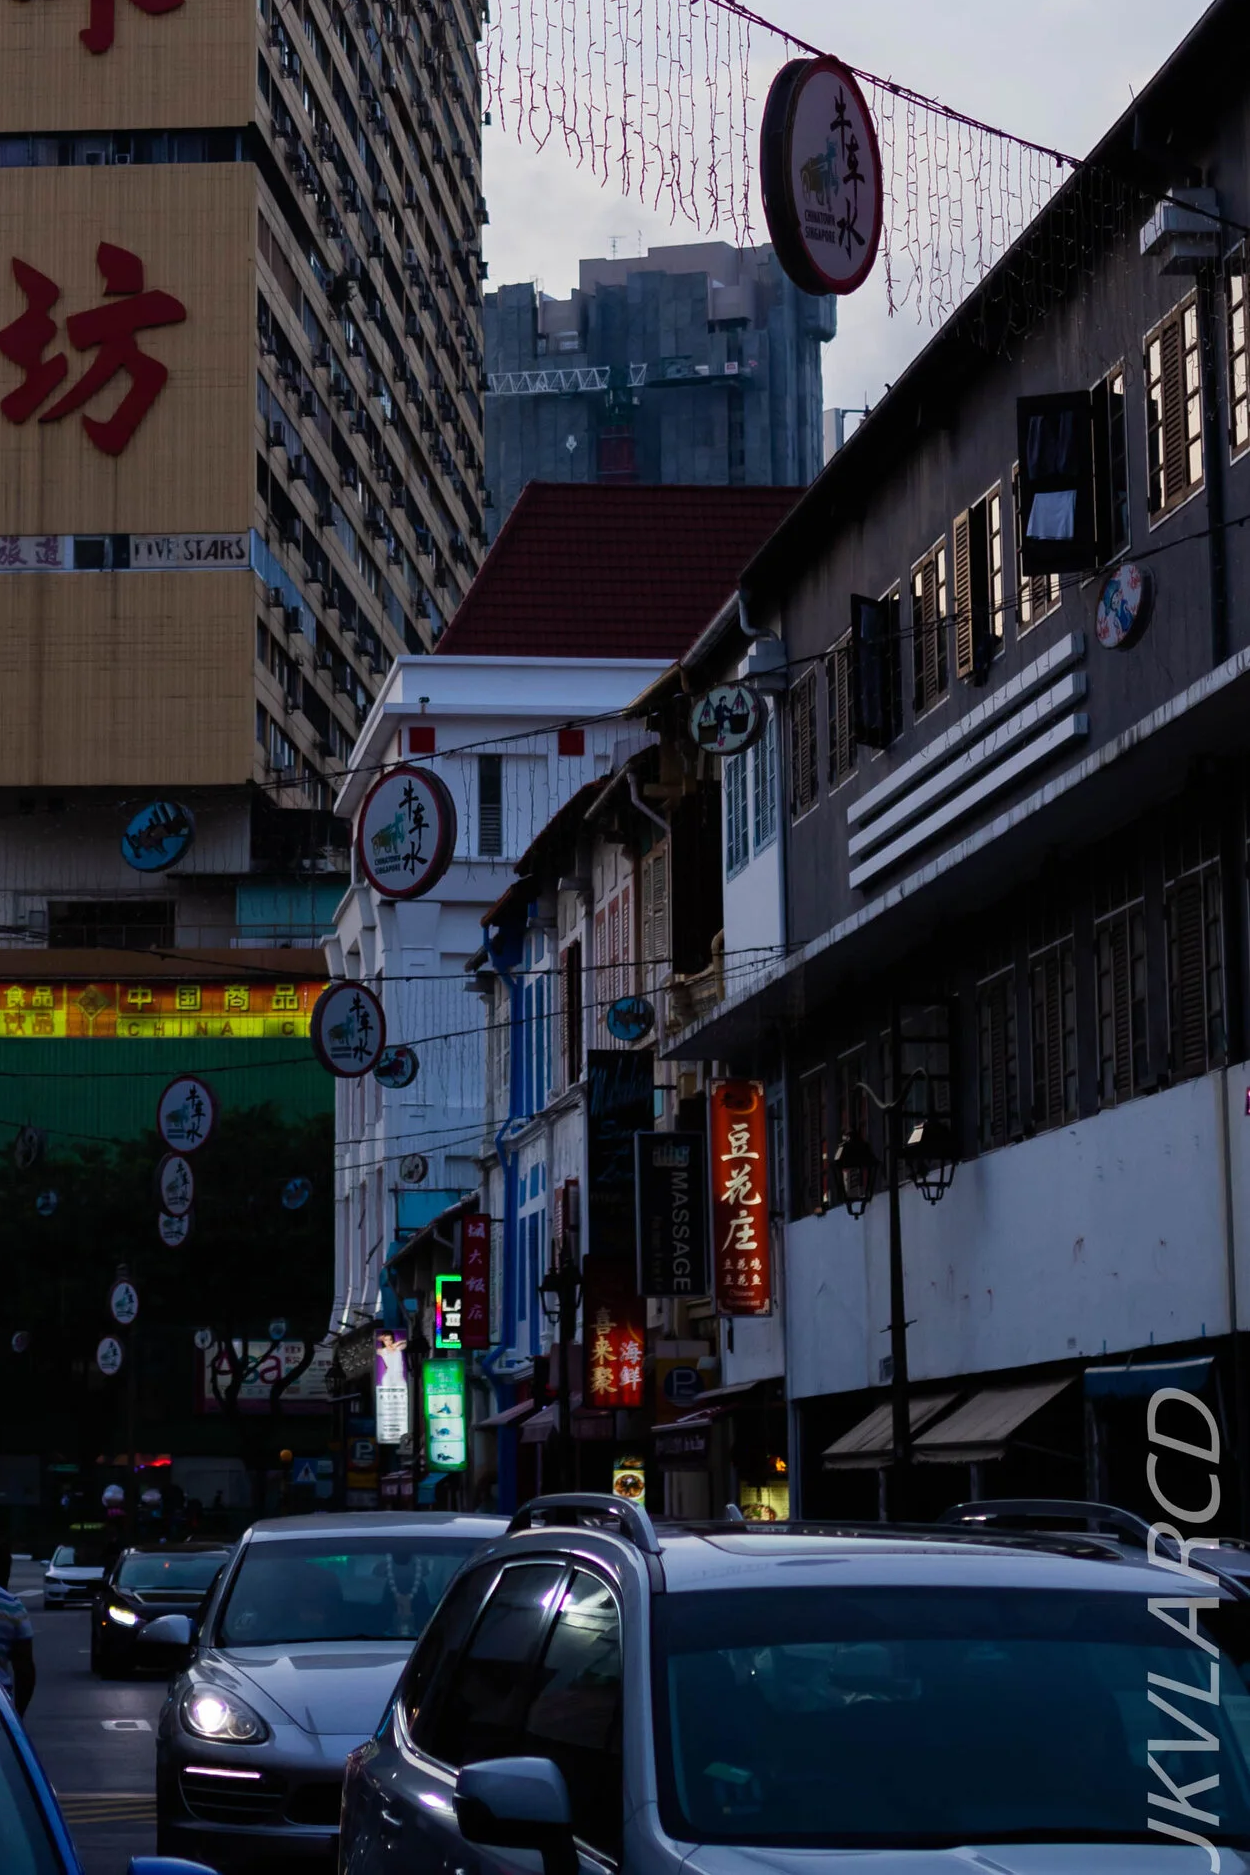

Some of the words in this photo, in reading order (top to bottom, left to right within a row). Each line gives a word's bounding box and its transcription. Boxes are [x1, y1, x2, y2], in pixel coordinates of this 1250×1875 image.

[804, 209, 836, 226] CHINATOWN
[804, 226, 836, 244] SINGAPORE
[183, 537, 246, 561] STARS
[3, 984, 55, 1009] 食品
[126, 983, 299, 1012] 中国商品
[127, 1021, 234, 1037] CHINA
[720, 1123, 762, 1252] 豆花庄
[671, 1171, 692, 1292] MASSAGE
